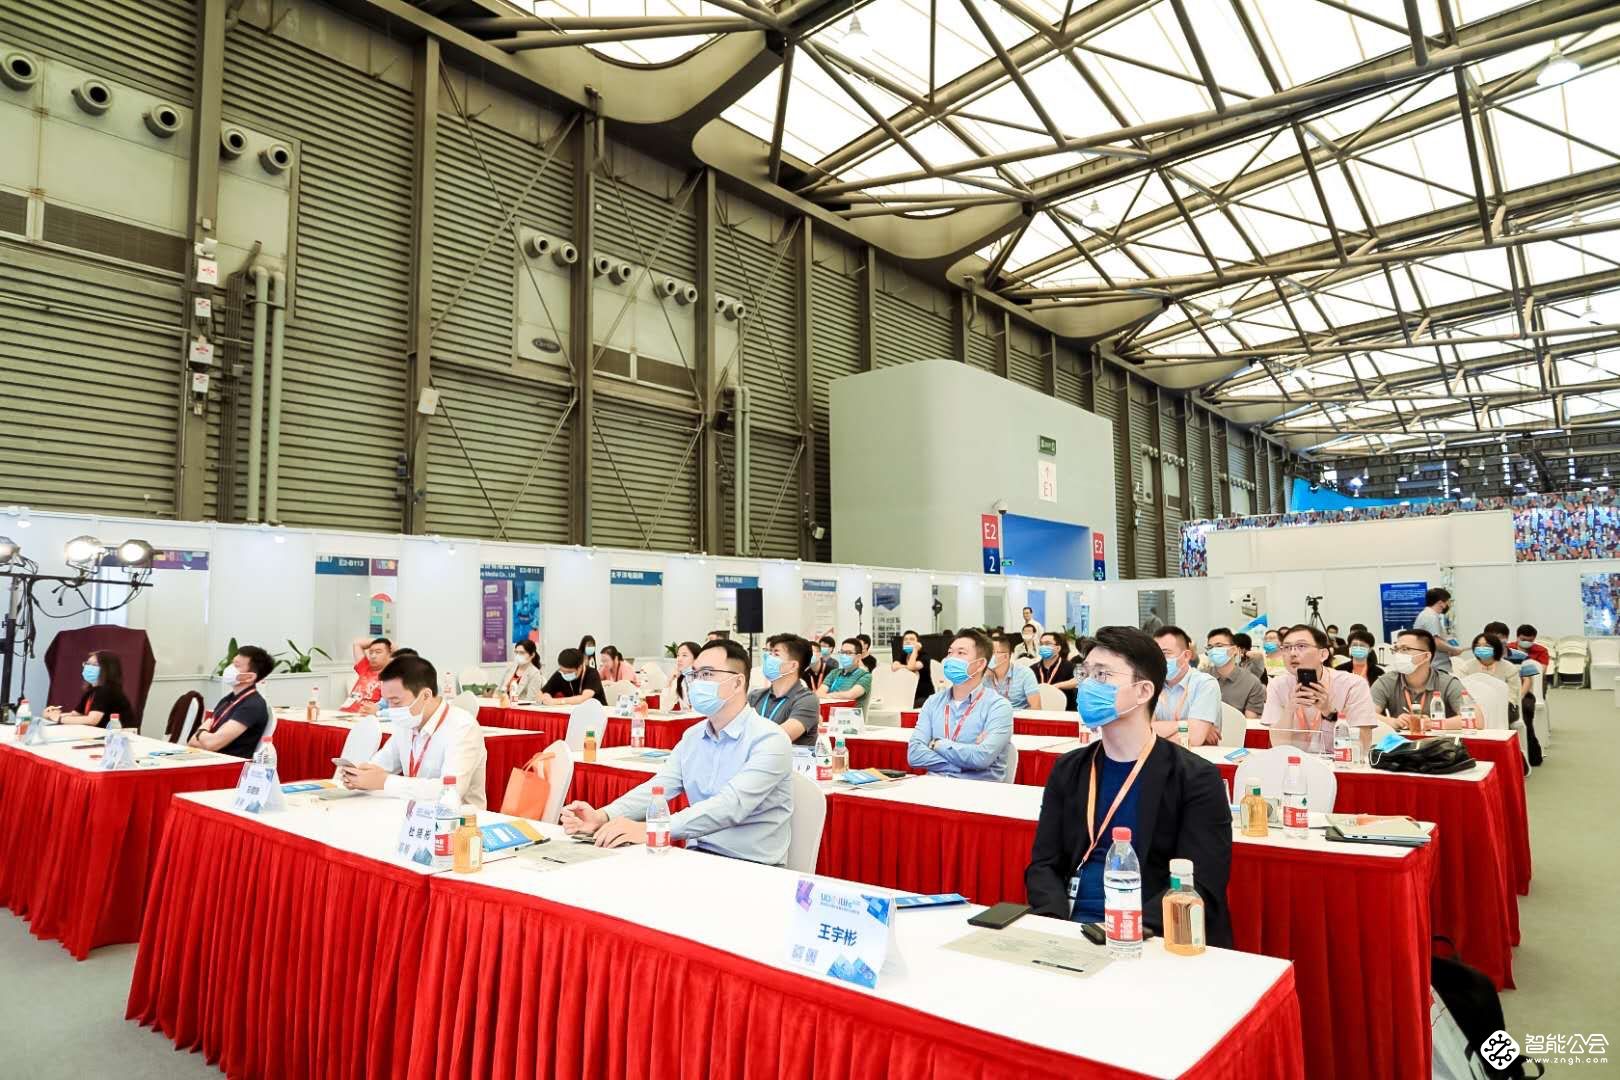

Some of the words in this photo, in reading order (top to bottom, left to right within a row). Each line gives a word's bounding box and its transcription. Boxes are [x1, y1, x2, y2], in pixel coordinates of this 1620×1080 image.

[1043, 481, 1053, 497] E1
[984, 523, 997, 540] E2
[1094, 539, 1103, 554] E2
[989, 556, 996, 572] 2
[818, 923, 858, 946] 王宇彬
